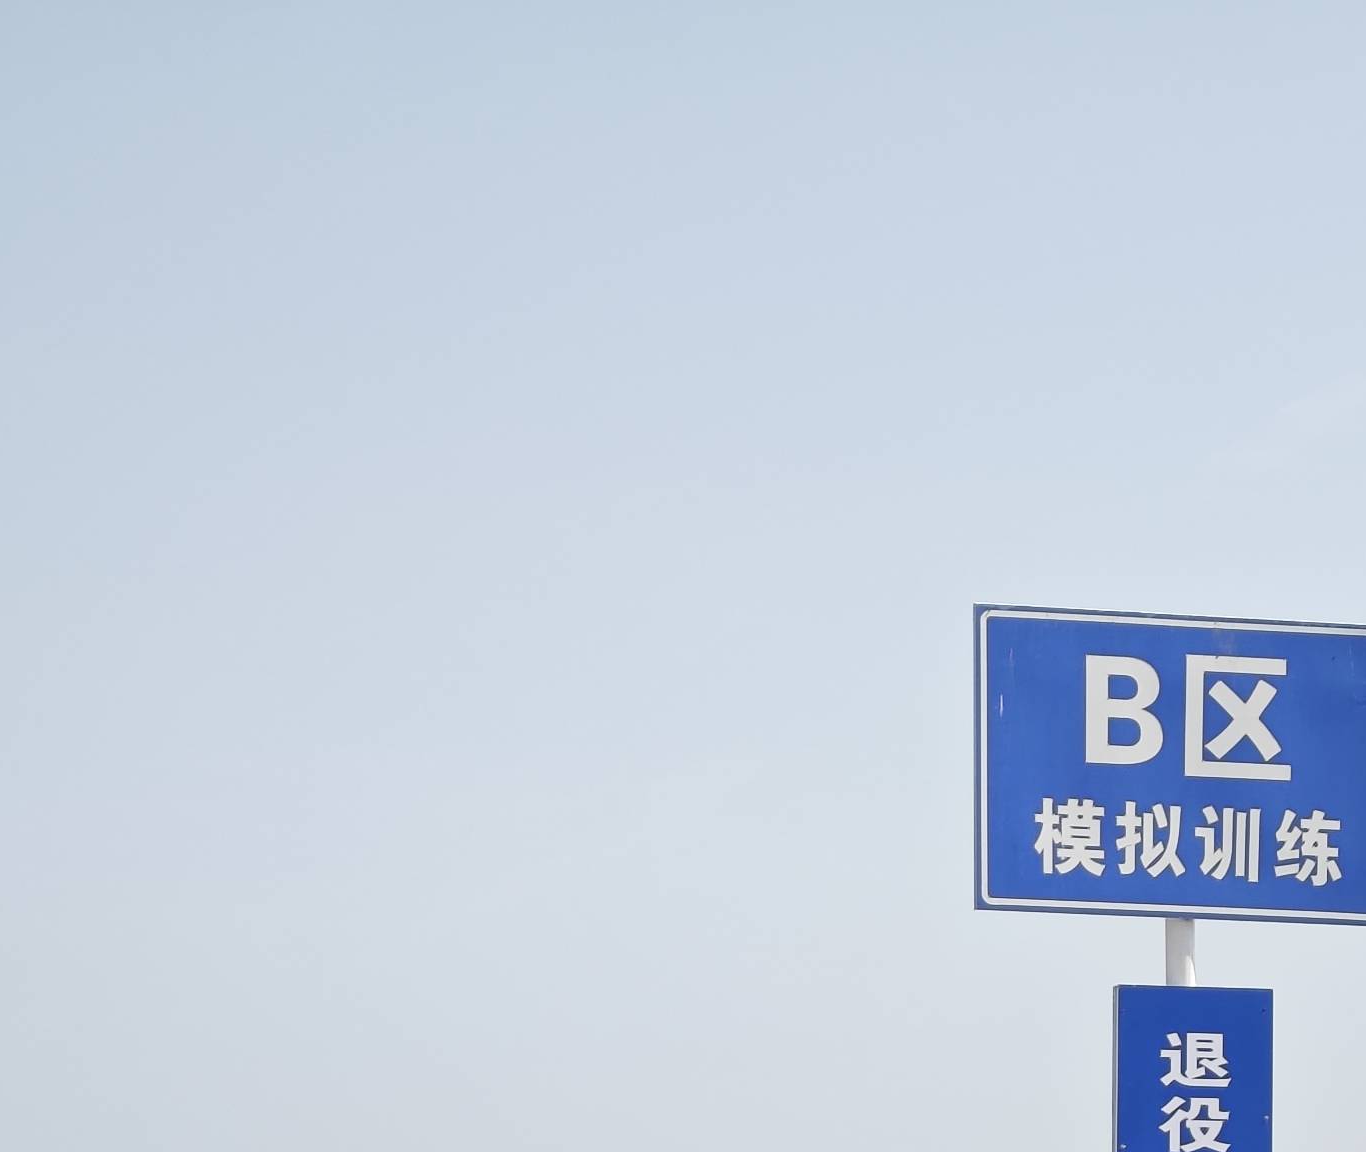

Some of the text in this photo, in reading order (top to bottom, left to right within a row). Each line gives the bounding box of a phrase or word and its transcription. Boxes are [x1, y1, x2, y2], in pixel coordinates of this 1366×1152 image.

[1085, 653, 1292, 781] B区
[1034, 797, 1343, 887] 模拟训练
